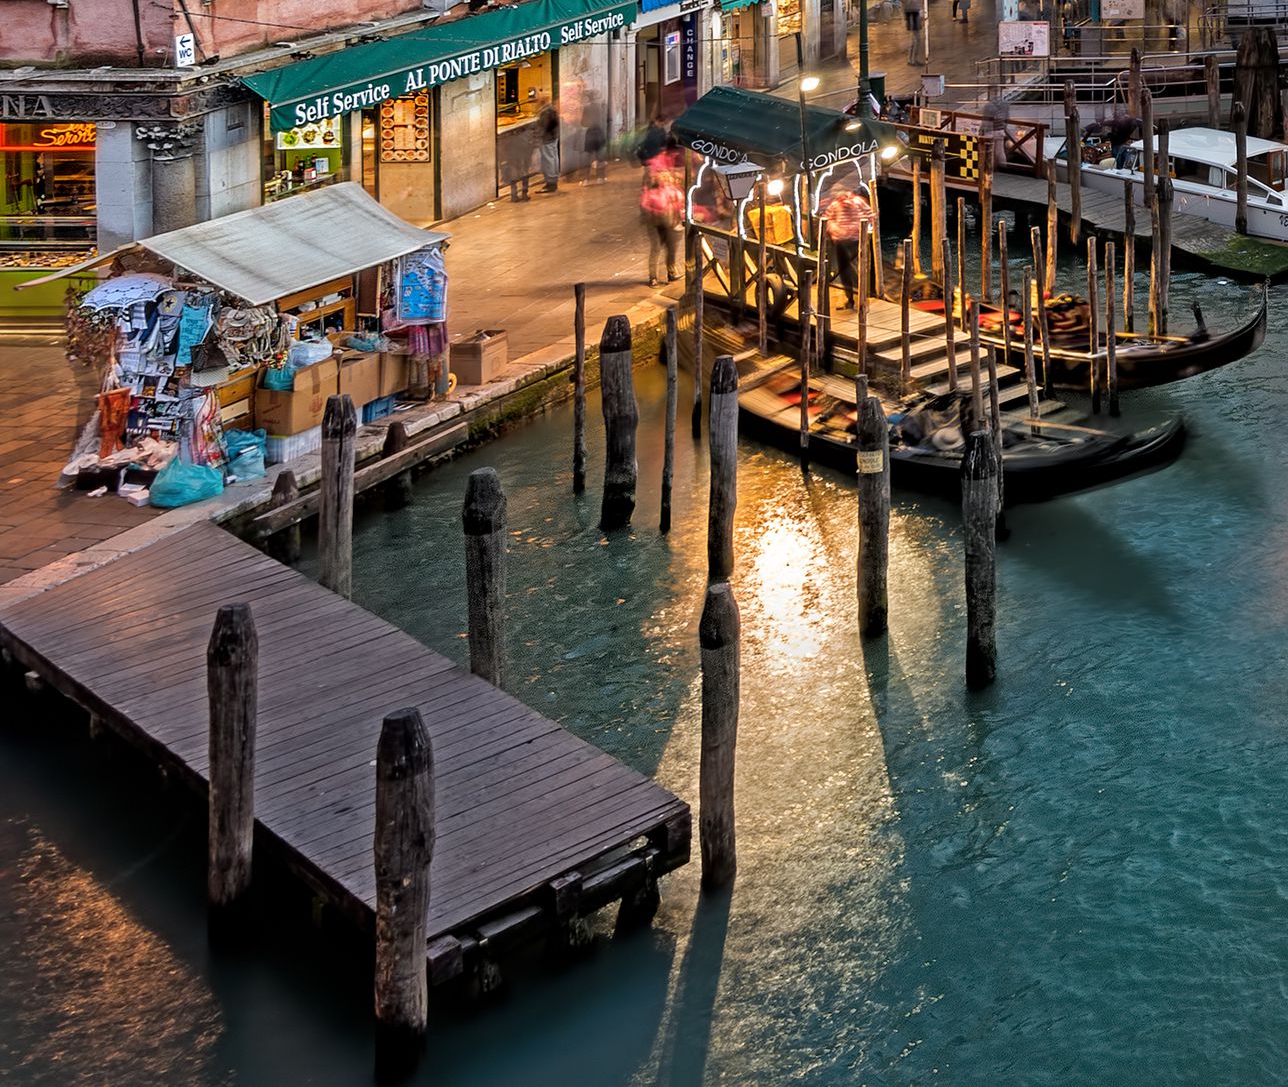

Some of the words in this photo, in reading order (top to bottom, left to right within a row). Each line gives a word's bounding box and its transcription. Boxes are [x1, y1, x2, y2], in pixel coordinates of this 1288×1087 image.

[178, 47, 193, 59] WC
[295, 99, 329, 127] Self
[333, 81, 390, 116] Service
[405, 71, 427, 93] AL
[429, 52, 481, 82] PONTE
[484, 46, 501, 68] DI
[502, 31, 551, 63] RIALTO
[561, 22, 584, 44] Self
[585, 11, 625, 38] Service
[686, 29, 694, 77] CHANGE
[691, 139, 749, 164] GONDOA
[800, 138, 880, 170] GONDOLA
